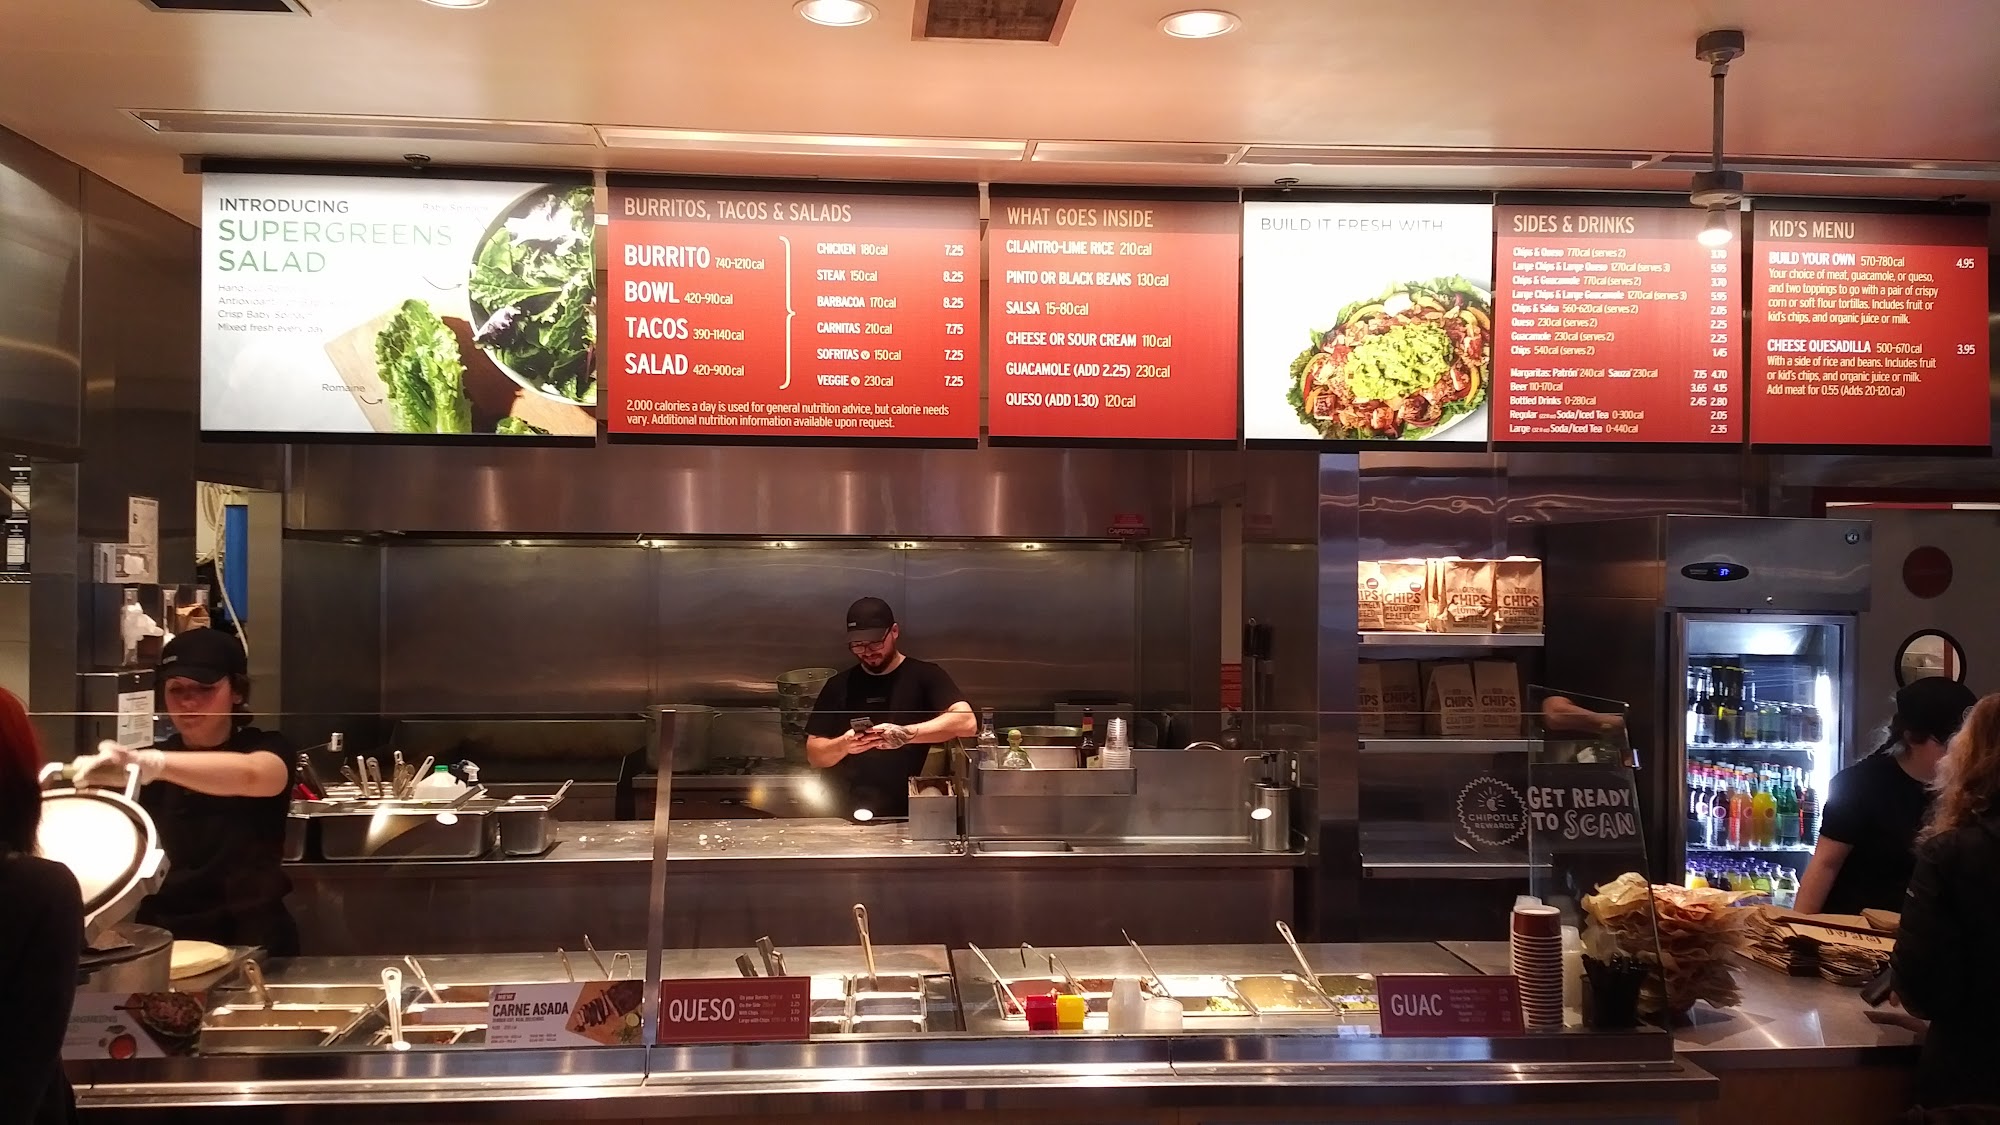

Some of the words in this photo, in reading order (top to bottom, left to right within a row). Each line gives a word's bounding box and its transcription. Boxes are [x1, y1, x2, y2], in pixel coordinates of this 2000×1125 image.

[220, 198, 348, 213] INTRODUCING
[624, 198, 711, 220] BURRITOS,
[718, 200, 767, 220] TACOS
[773, 202, 784, 221] &
[789, 203, 852, 222] SALADS
[1007, 207, 1050, 225] WHAT
[1056, 208, 1097, 226] GOES
[1103, 209, 1154, 227] INSIDE
[1513, 215, 1557, 232] SIDES
[1562, 216, 1573, 232] &
[1578, 216, 1635, 233] DRINKS
[1261, 218, 1311, 231] BUILD
[1318, 219, 1331, 231] IT
[1338, 219, 1391, 231] FRESH
[1399, 220, 1442, 231] WITH
[1770, 220, 1807, 238] KID'S
[1813, 222, 1855, 238] MENU
[219, 220, 452, 246] SUPERGREENS
[817, 242, 856, 254] CHICKEN
[944, 244, 963, 256] 7.25
[1006, 240, 1087, 254] CILANTRO-LIME
[1090, 241, 1114, 255] RICE
[219, 250, 326, 273] SALAD
[625, 244, 710, 268] BURRITO
[1769, 252, 1799, 265] BUILD
[1802, 253, 1829, 265] YOUR
[1832, 253, 1855, 265] OWN
[1956, 258, 1974, 268] 4.95
[817, 269, 846, 281] STEAK
[943, 271, 963, 282] 8.25
[1006, 270, 1038, 284] PINTO
[1040, 271, 1056, 284] OR
[1059, 271, 1093, 285] BLACK
[1096, 272, 1131, 286] BEANS
[1769, 269, 1787, 279] Your
[1789, 269, 1814, 279] choice
[1816, 269, 1825, 280] of
[1827, 270, 1849, 281] meat,
[1851, 271, 1896, 282] guacamole,
[1898, 273, 1906, 281] or
[1908, 273, 1934, 283] queso,
[625, 280, 680, 303] BOWL
[817, 295, 865, 307] BARBACOA
[943, 297, 963, 308] 8.25
[1006, 301, 1040, 314] SALSA
[218, 310, 243, 318] Crisp
[218, 323, 246, 331] Mixed
[625, 317, 688, 339] TACOS
[817, 322, 860, 333] CARNITAS
[945, 323, 963, 334] 7.75
[1006, 331, 1047, 345] CHEESE
[1049, 332, 1065, 345] OR
[1067, 333, 1097, 346] SOUR
[1099, 333, 1136, 346] CREAM
[1767, 339, 1806, 352] CHEESE
[1809, 340, 1871, 353] QUESADILLA
[1957, 344, 1975, 354] 3.95
[817, 348, 859, 360] SOFRITAS
[944, 349, 963, 360] 7.25
[625, 353, 688, 374] SALAD
[1006, 362, 1071, 376] GUACAMOLE
[1073, 363, 1100, 377] (ADD
[1102, 364, 1130, 378] 2.25)
[817, 375, 849, 386] VEGGIE
[944, 375, 963, 386] 7.25
[1510, 382, 1528, 391] Beer
[1690, 383, 1707, 392] 3.65
[1713, 384, 1727, 392] 4.15
[322, 384, 365, 392] Romaine
[1006, 392, 1042, 406] QUESO
[1045, 393, 1071, 407] (ADD
[1073, 394, 1099, 408] 1.30)
[1510, 396, 1537, 405] Bottled
[1538, 396, 1561, 405] Drinks
[1690, 397, 1707, 406] 2.45
[1710, 397, 1727, 406] 2.80
[627, 399, 653, 411] 2,000
[654, 400, 690, 414] calories
[692, 404, 698, 412] a
[699, 401, 716, 415] day
[718, 401, 726, 415] is
[728, 402, 750, 416] used
[751, 401, 765, 416] for
[766, 402, 800, 416] general
[802, 402, 840, 414] nutrition
[842, 403, 873, 415] advice,
[874, 403, 889, 414] but
[891, 404, 921, 414] calorie
[923, 404, 949, 415] needs
[627, 415, 649, 426] vary.
[651, 414, 696, 425] Additional
[699, 414, 737, 425] nutrition
[740, 415, 791, 426] information
[793, 416, 833, 427] available
[835, 419, 857, 429] upon
[859, 417, 894, 429] request.
[1510, 410, 1538, 420] Regular
[1596, 410, 1609, 419] Tea
[1710, 411, 1727, 419] 2.05
[1509, 424, 1531, 434] Large
[1589, 424, 1602, 432] Tea
[1710, 424, 1727, 433] 2.35
[1360, 590, 1378, 600] IPS
[1385, 593, 1421, 603] CHIPS
[1452, 595, 1487, 605] CHIPS
[1503, 596, 1539, 607] CHIPS
[1360, 694, 1378, 706] IPS
[1445, 696, 1473, 708] CHIPS
[1481, 695, 1516, 707] CHIPS
[1527, 786, 1565, 809] GET
[1573, 788, 1630, 809] READY
[1468, 813, 1519, 822] CHIPOTLE
[1532, 812, 1559, 831] TO
[1564, 810, 1636, 839] SCAN
[493, 1003, 530, 1016] CARNE
[533, 1002, 568, 1015] ASADA
[669, 998, 735, 1022] QUESO
[1391, 994, 1443, 1017] GUAC
